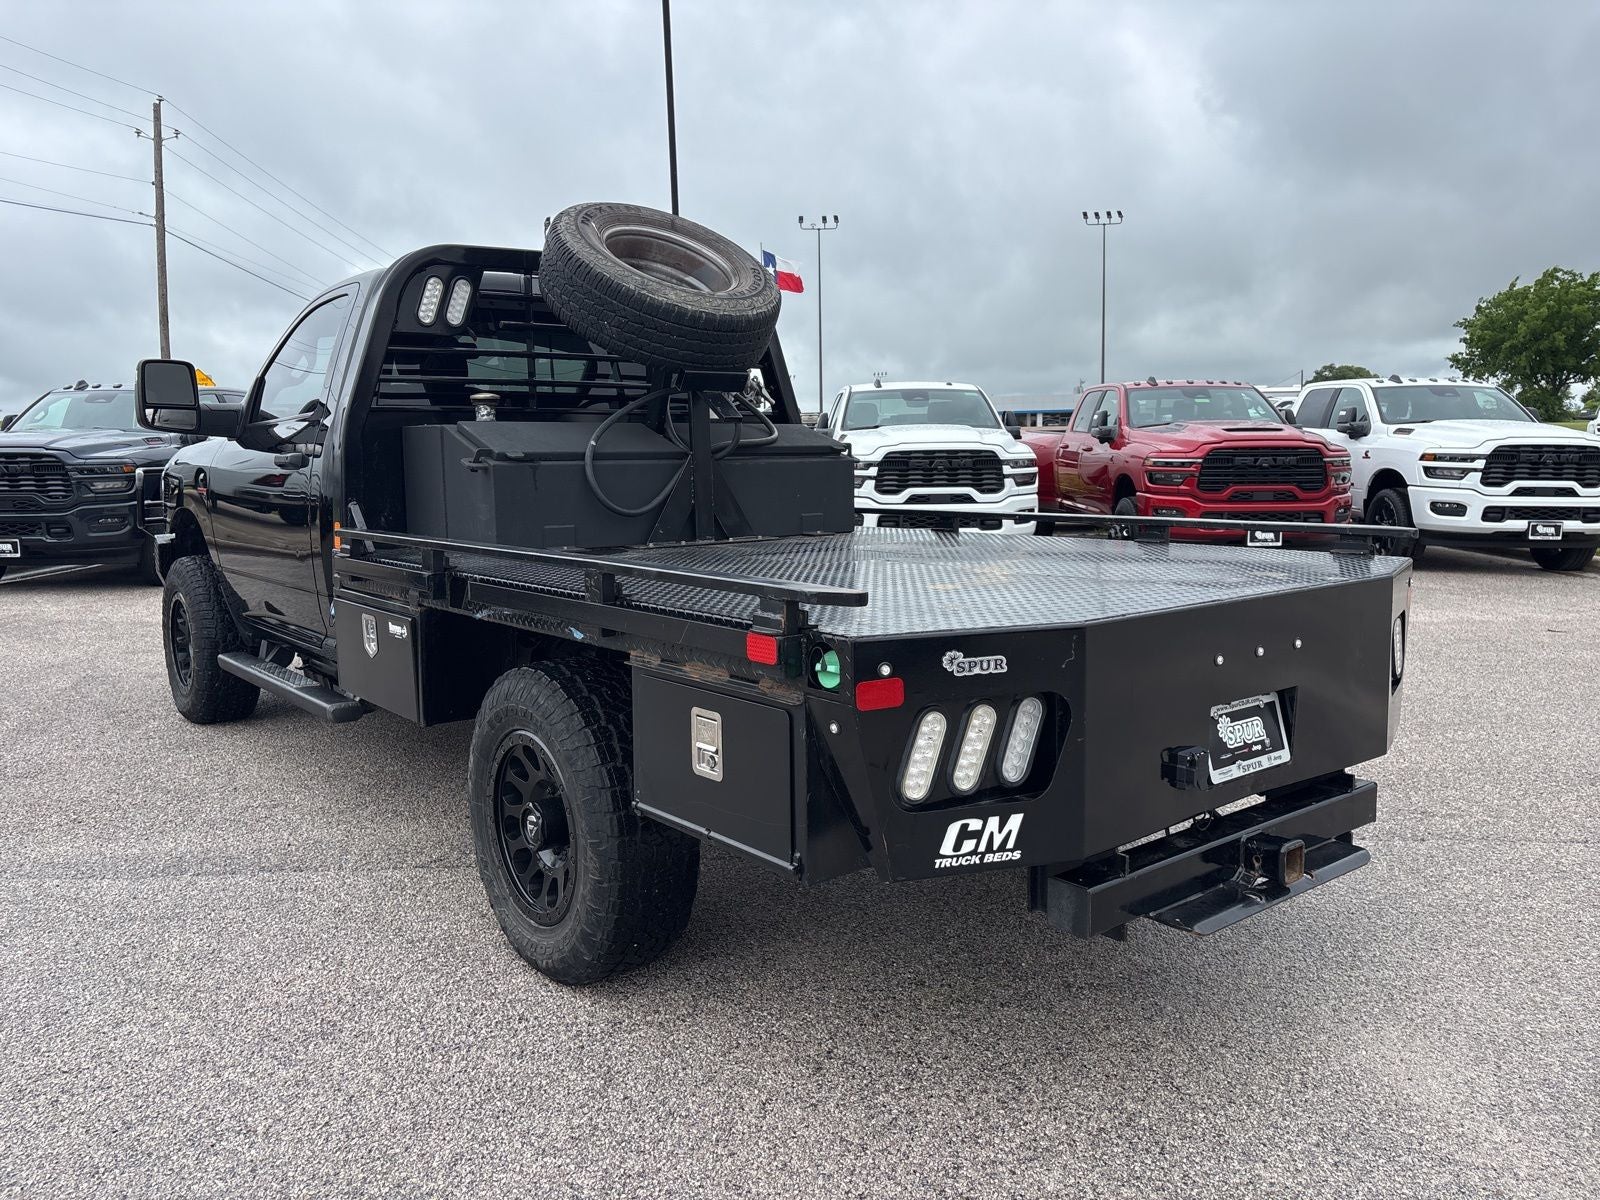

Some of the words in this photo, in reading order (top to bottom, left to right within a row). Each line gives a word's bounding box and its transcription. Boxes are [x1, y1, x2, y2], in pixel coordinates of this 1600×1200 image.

[908, 459, 974, 469] RAM
[1234, 456, 1299, 466] RAM
[1520, 453, 1582, 463] RAM
[956, 657, 1007, 674] SPUR
[1226, 718, 1265, 747] SPUR
[1251, 744, 1262, 752] Jeep
[1241, 760, 1264, 774] SPUR
[938, 813, 1025, 857] CM
[934, 853, 981, 869] TRUCK
[983, 850, 1022, 864] BEDS
